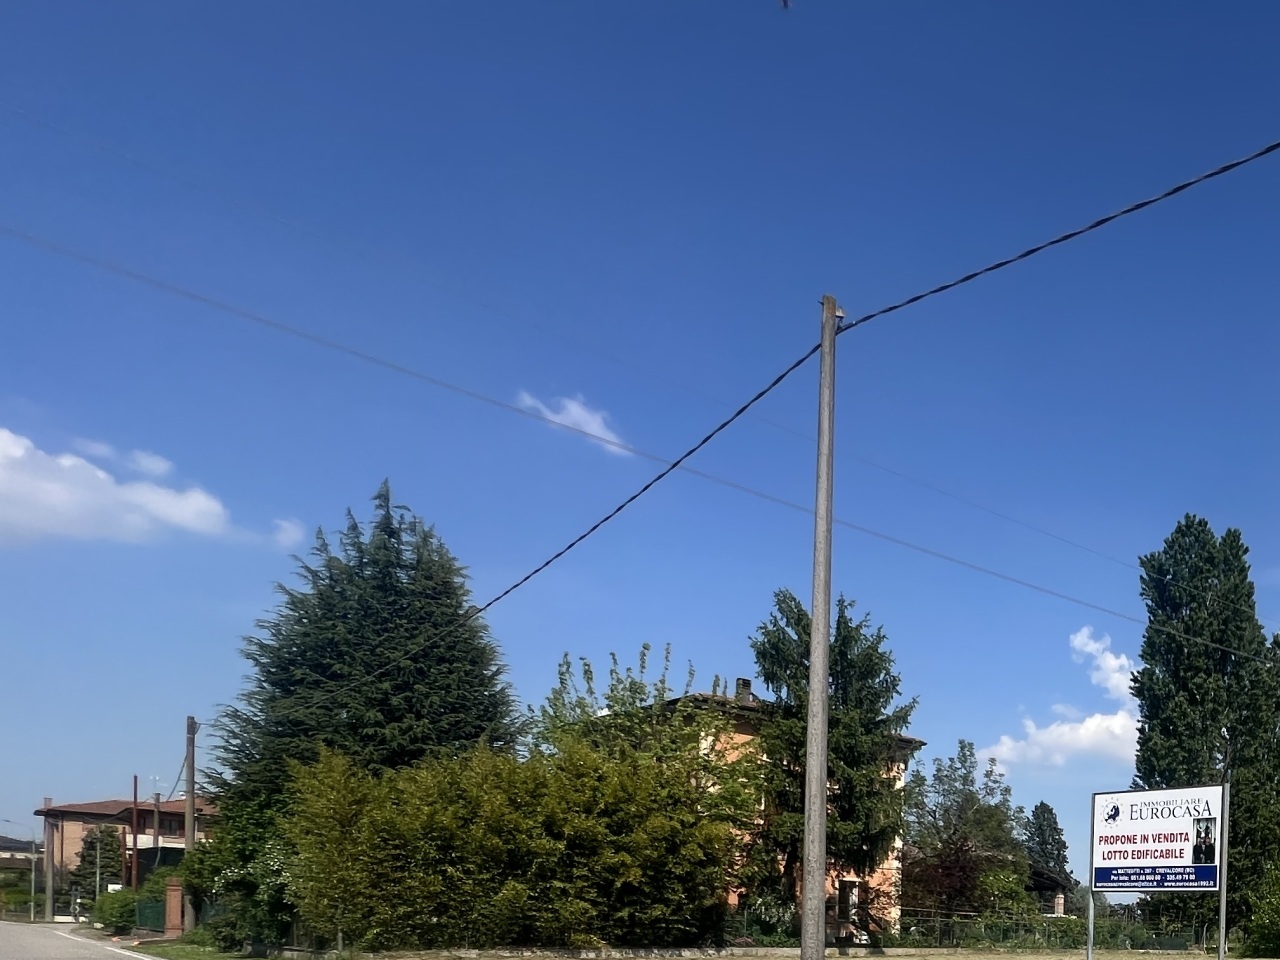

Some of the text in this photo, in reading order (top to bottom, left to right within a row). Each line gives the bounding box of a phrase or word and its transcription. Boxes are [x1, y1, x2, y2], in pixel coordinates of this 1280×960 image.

[1140, 798, 1204, 808] IMMOBILIARE
[1130, 800, 1212, 820] EUROCASA
[1099, 832, 1190, 846] PROPONE IN VENDITA
[1102, 848, 1185, 861] LOTTO EDIFICABILE
